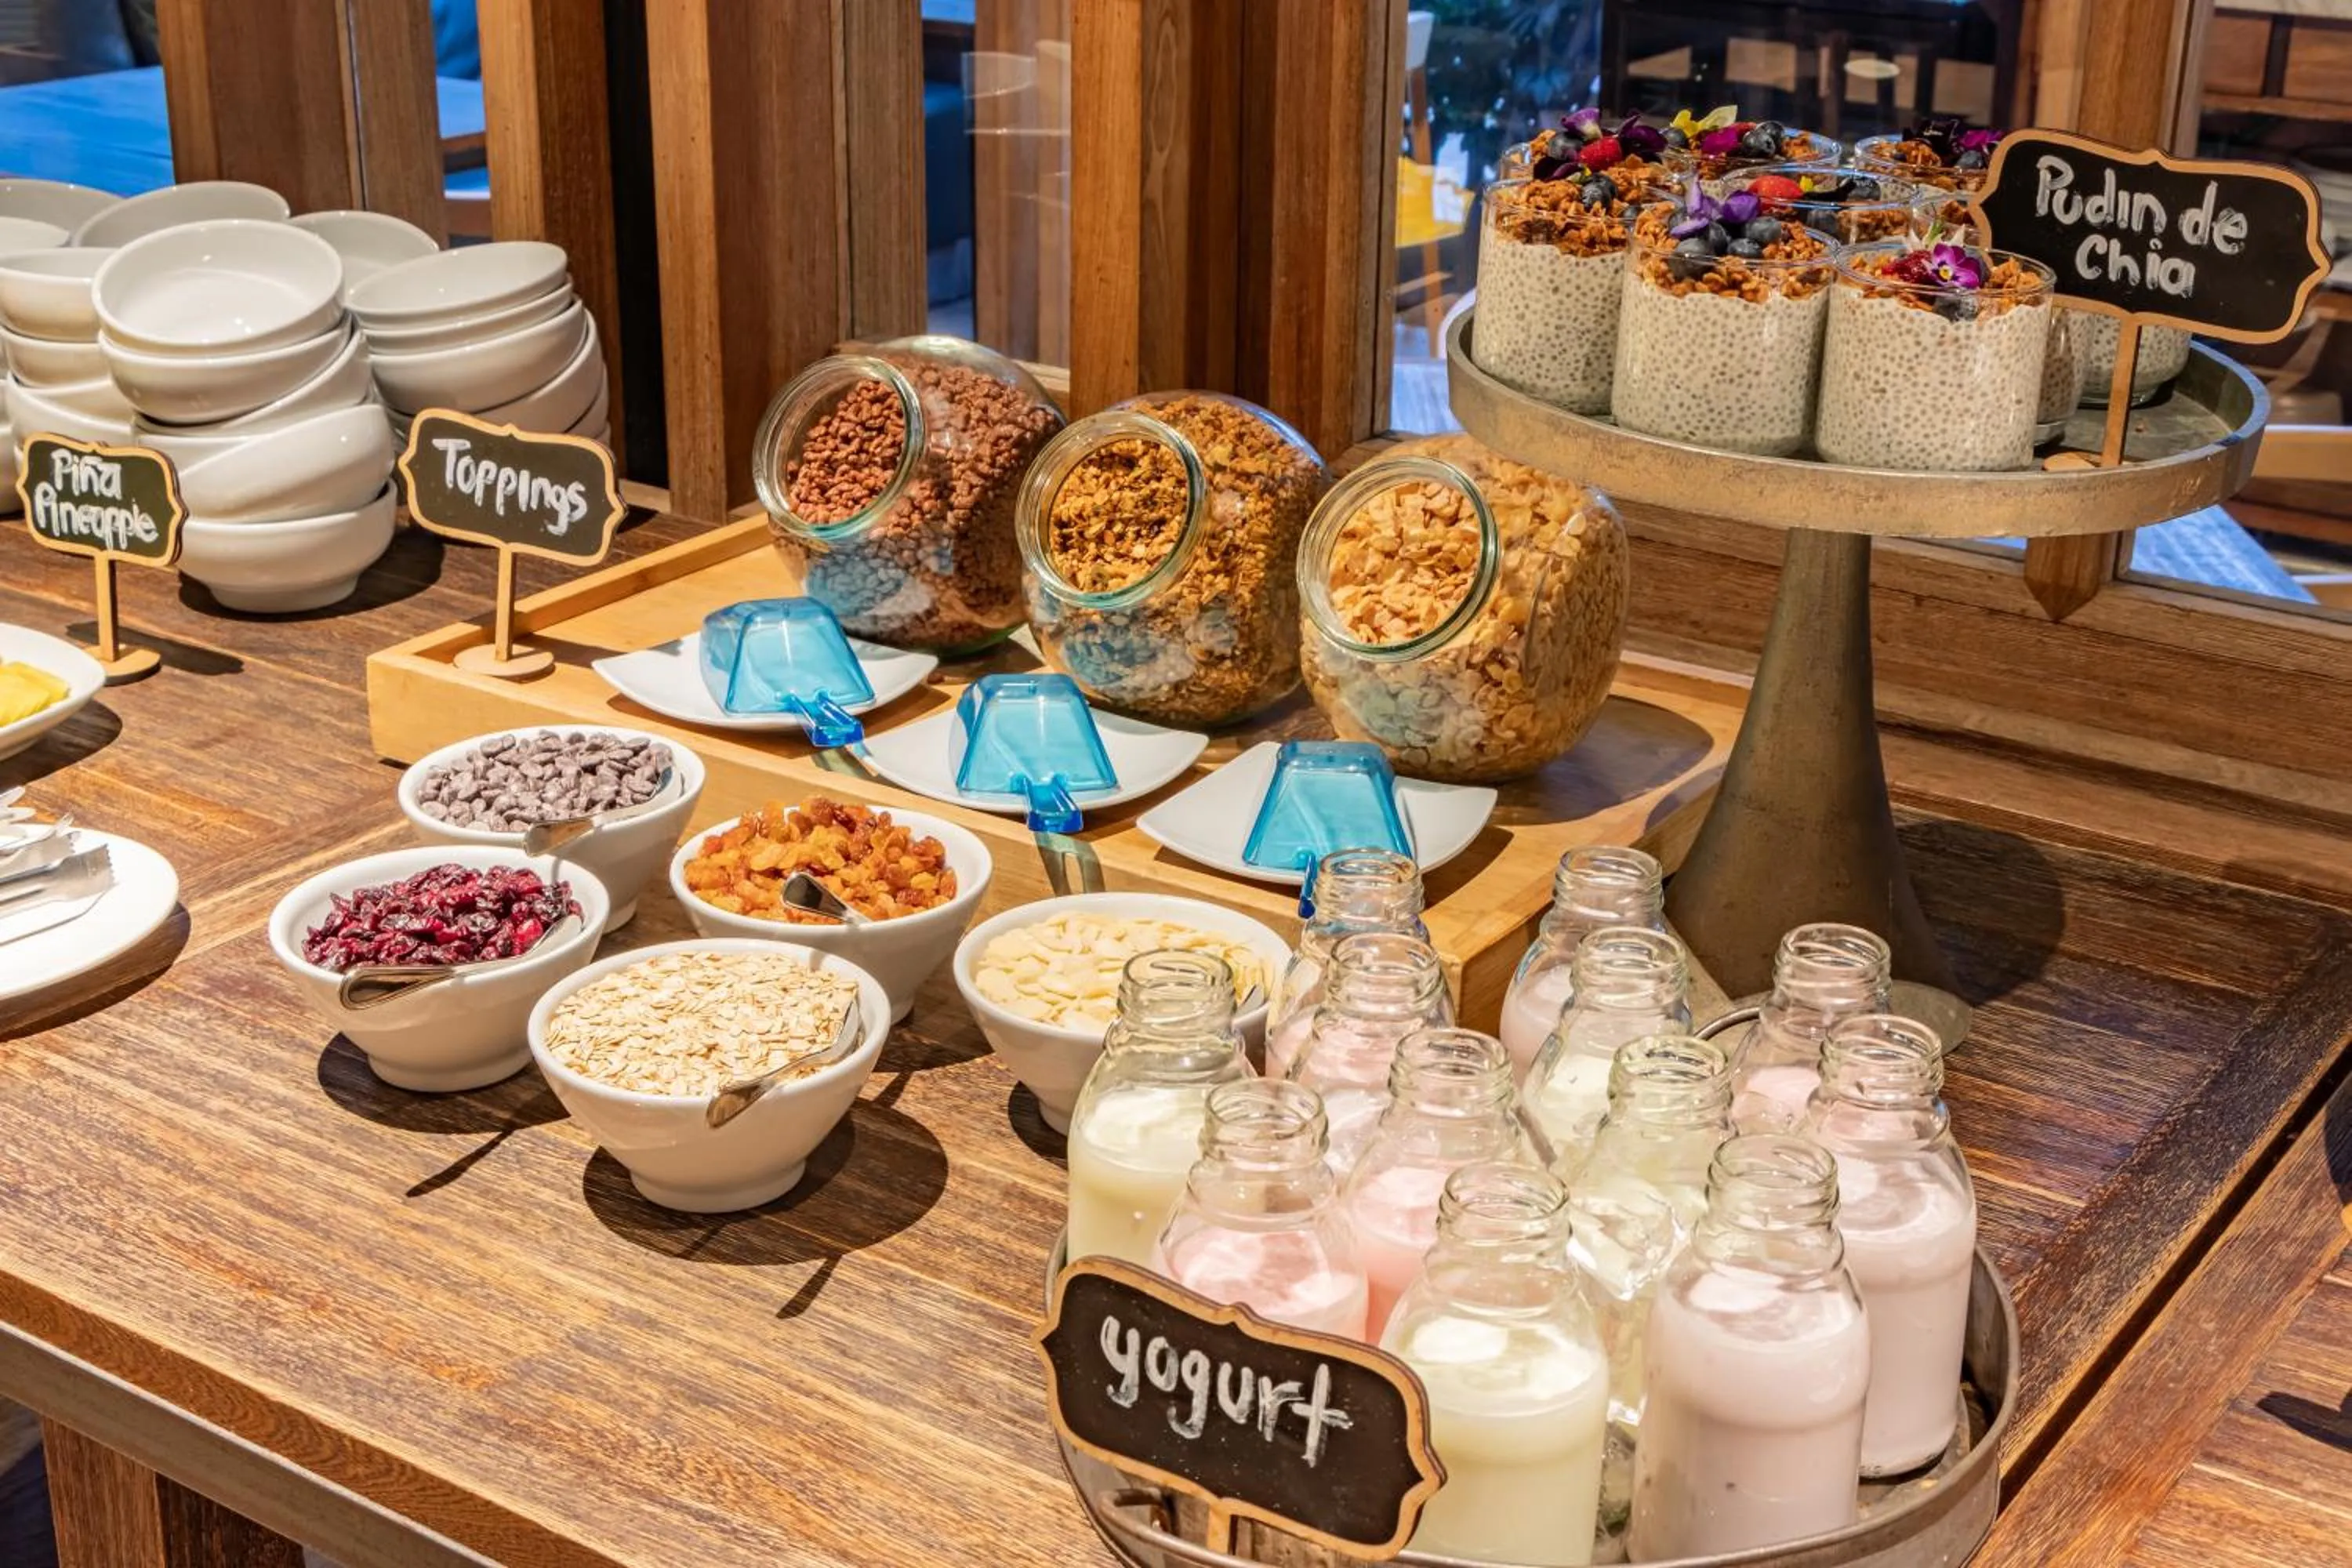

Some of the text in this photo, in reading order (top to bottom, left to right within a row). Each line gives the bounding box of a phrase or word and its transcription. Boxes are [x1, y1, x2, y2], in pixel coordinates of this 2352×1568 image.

[2036, 155, 2249, 255] Pudin de
[34, 481, 158, 550] Pineapple
[51, 448, 122, 500] Piña
[432, 438, 588, 536] Toppings
